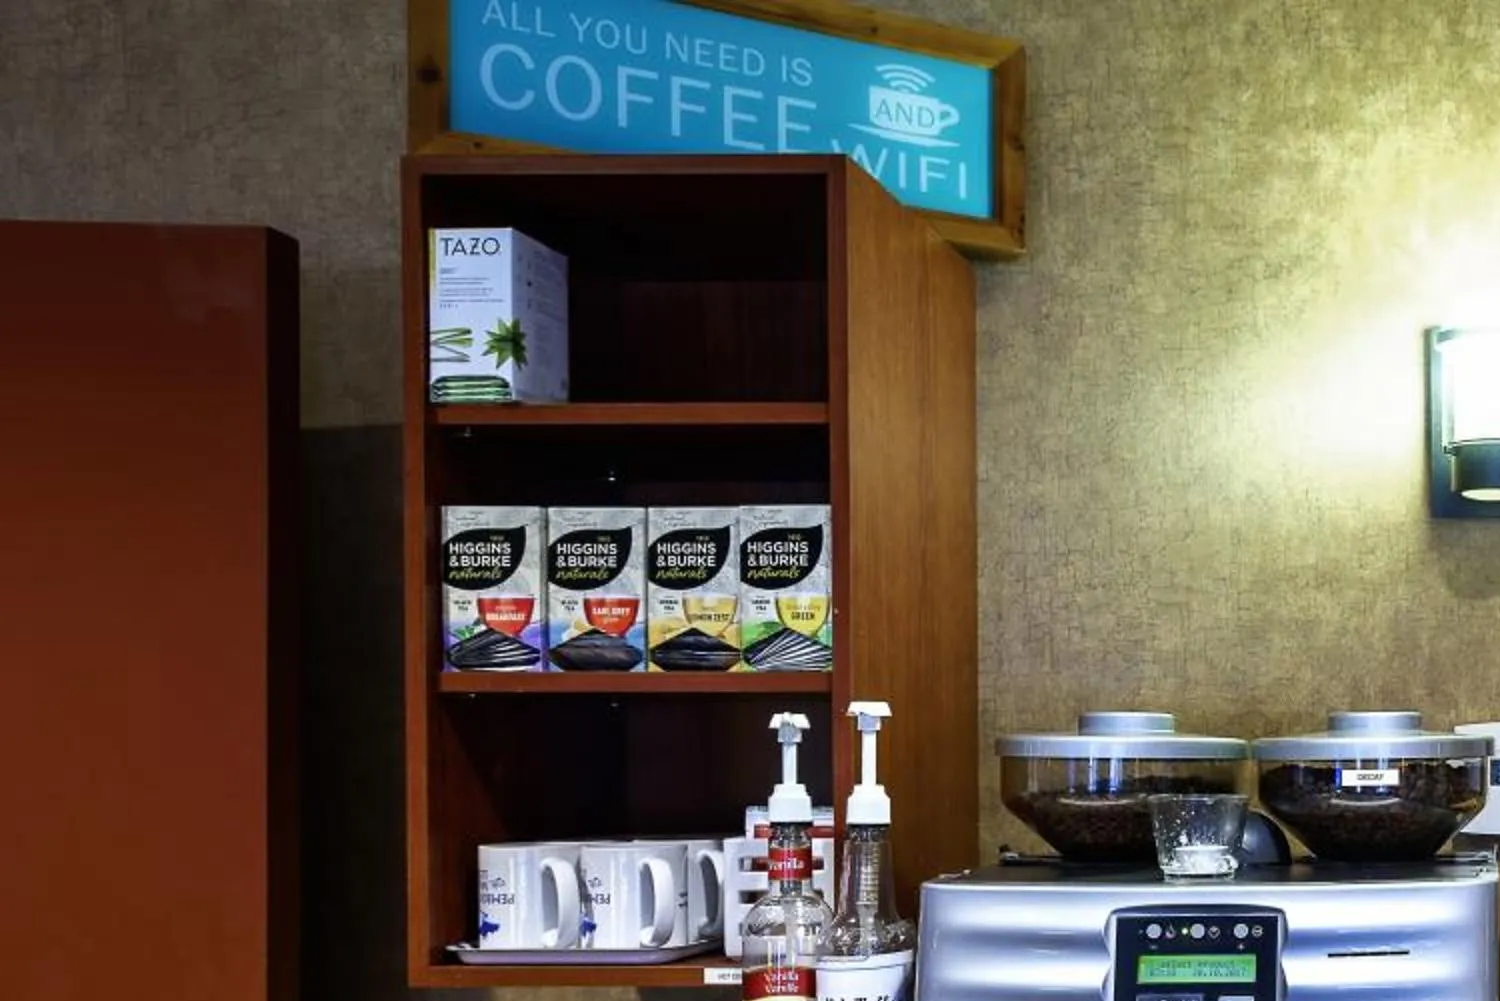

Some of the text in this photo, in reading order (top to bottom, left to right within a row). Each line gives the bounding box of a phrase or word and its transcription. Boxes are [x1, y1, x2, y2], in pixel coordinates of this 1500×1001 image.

[482, 0, 814, 87] ALL YOU NEED IS
[478, 42, 818, 155] COFFEE
[873, 98, 936, 129] AND
[439, 236, 502, 257] TAZO
[449, 543, 512, 555] HIGGINS
[556, 543, 618, 555] HIGGINS
[656, 543, 717, 555] HIGGINS
[746, 541, 810, 553] HIGGINS
